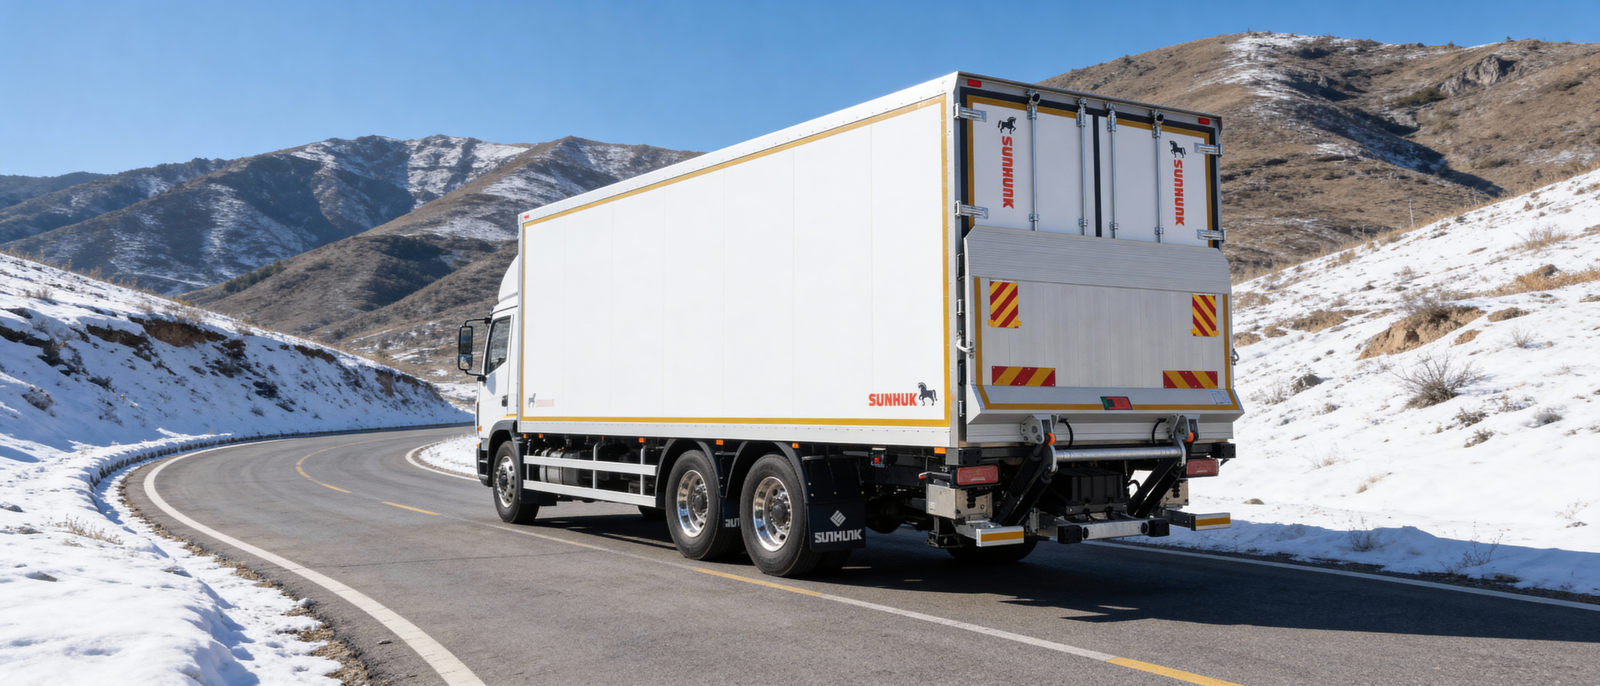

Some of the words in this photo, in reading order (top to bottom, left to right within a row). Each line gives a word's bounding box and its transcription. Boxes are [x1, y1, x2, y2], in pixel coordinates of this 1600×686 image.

[1002, 136, 1014, 209] SUNHUNK
[1173, 159, 1185, 226] SUNHUNK
[868, 393, 917, 406] SUNHUK
